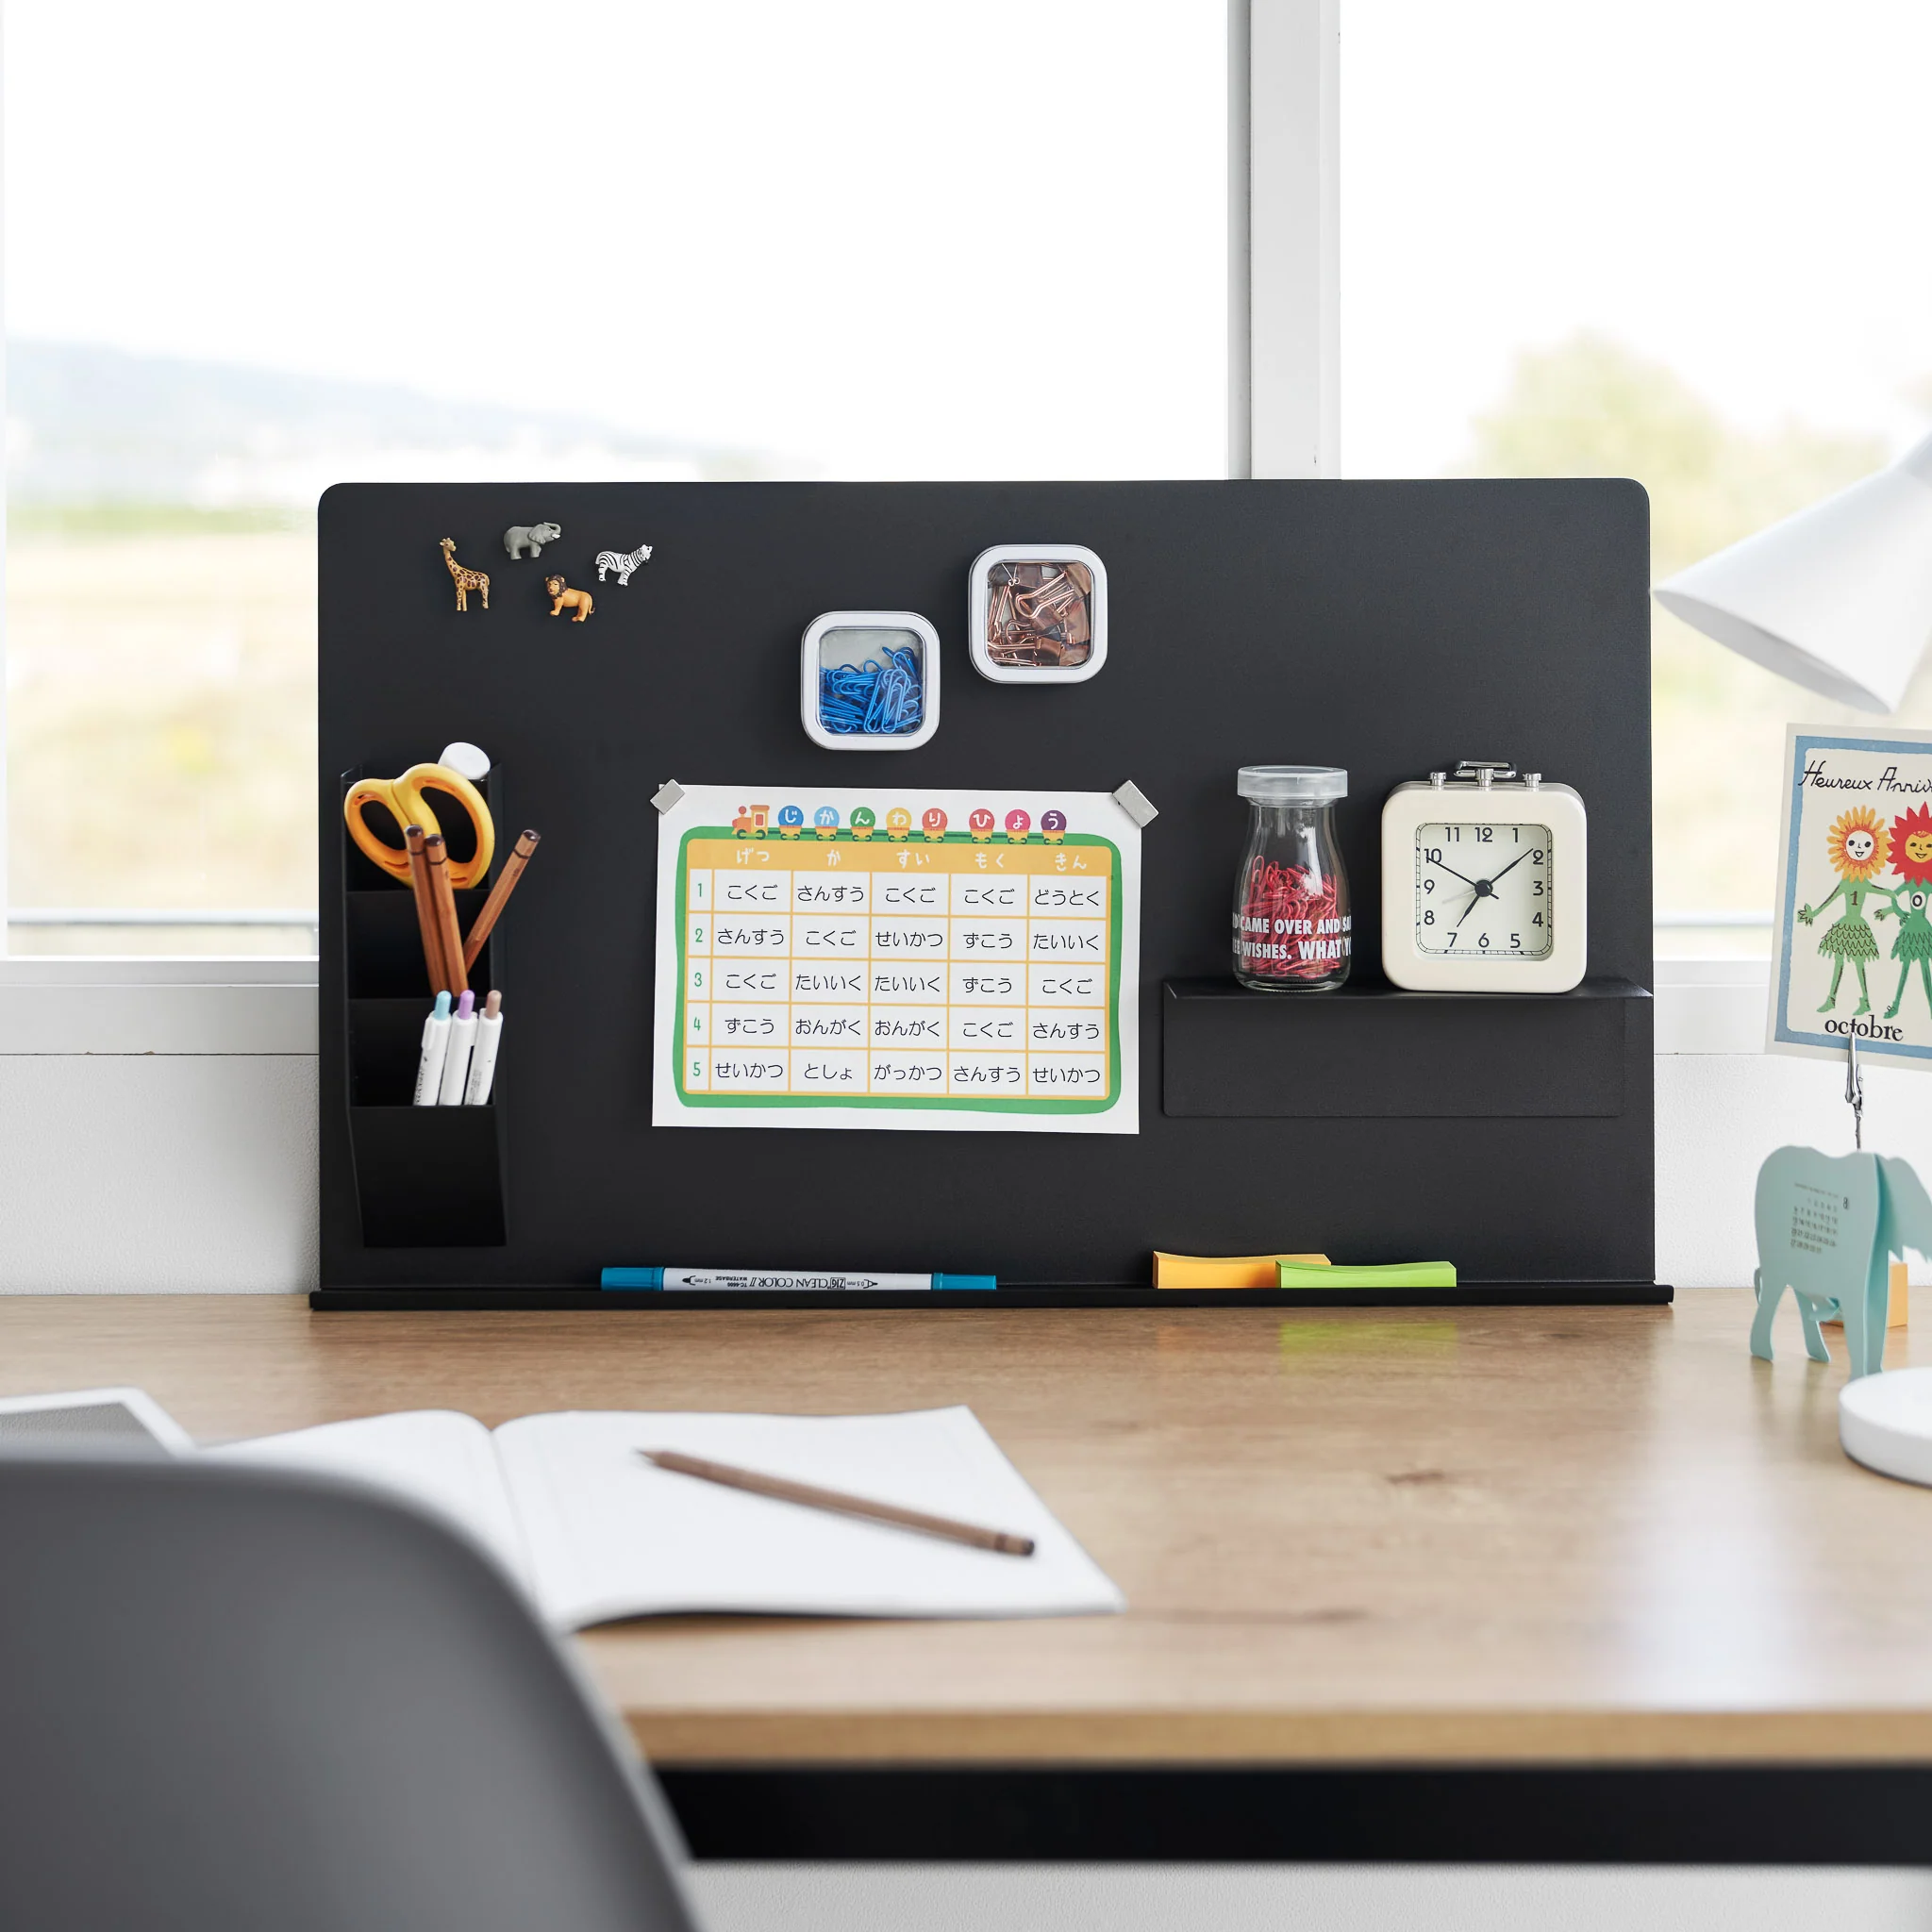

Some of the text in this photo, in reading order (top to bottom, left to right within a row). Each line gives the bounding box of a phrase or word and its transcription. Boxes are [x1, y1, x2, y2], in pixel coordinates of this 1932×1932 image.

[1797, 759, 1874, 791] Heureux
[785, 809, 1062, 830] じかんわり ひょう
[1444, 826, 1519, 843] 11 12 1
[736, 847, 1088, 872] げつ か すい もく きん
[1424, 848, 1442, 864] 10
[1532, 849, 1544, 865] 2
[696, 883, 1099, 907] 1 こくご さんすう こくご こくご どうとく
[1424, 879, 1436, 895] 9
[1532, 880, 1544, 896] 3
[1241, 916, 1270, 934] CAME
[1274, 918, 1313, 935] OVER
[1316, 918, 1341, 934] AND
[1424, 909, 1436, 925] 8
[1531, 911, 1544, 927] 4
[695, 927, 1099, 951] 2 さんすう こくご せいかつ ずこう たいいく
[1446, 932, 1522, 949] 7 6 5
[1241, 941, 1292, 960] WISHES.
[1297, 939, 1342, 960] WHAT
[693, 972, 1093, 994] 3 こくご たいいく たいいく ずこう こくご
[693, 1018, 1100, 1040] 4 ずこう おんがく おんがく こくご さんすう
[1824, 1014, 1904, 1041] octobre
[693, 1061, 1101, 1084] 5 せいかつ としょ がっかつ さんすう せいかつ
[758, 1277, 794, 1288] COLOR
[795, 1278, 829, 1289] CLEAN
[830, 1277, 846, 1290] ZIG
